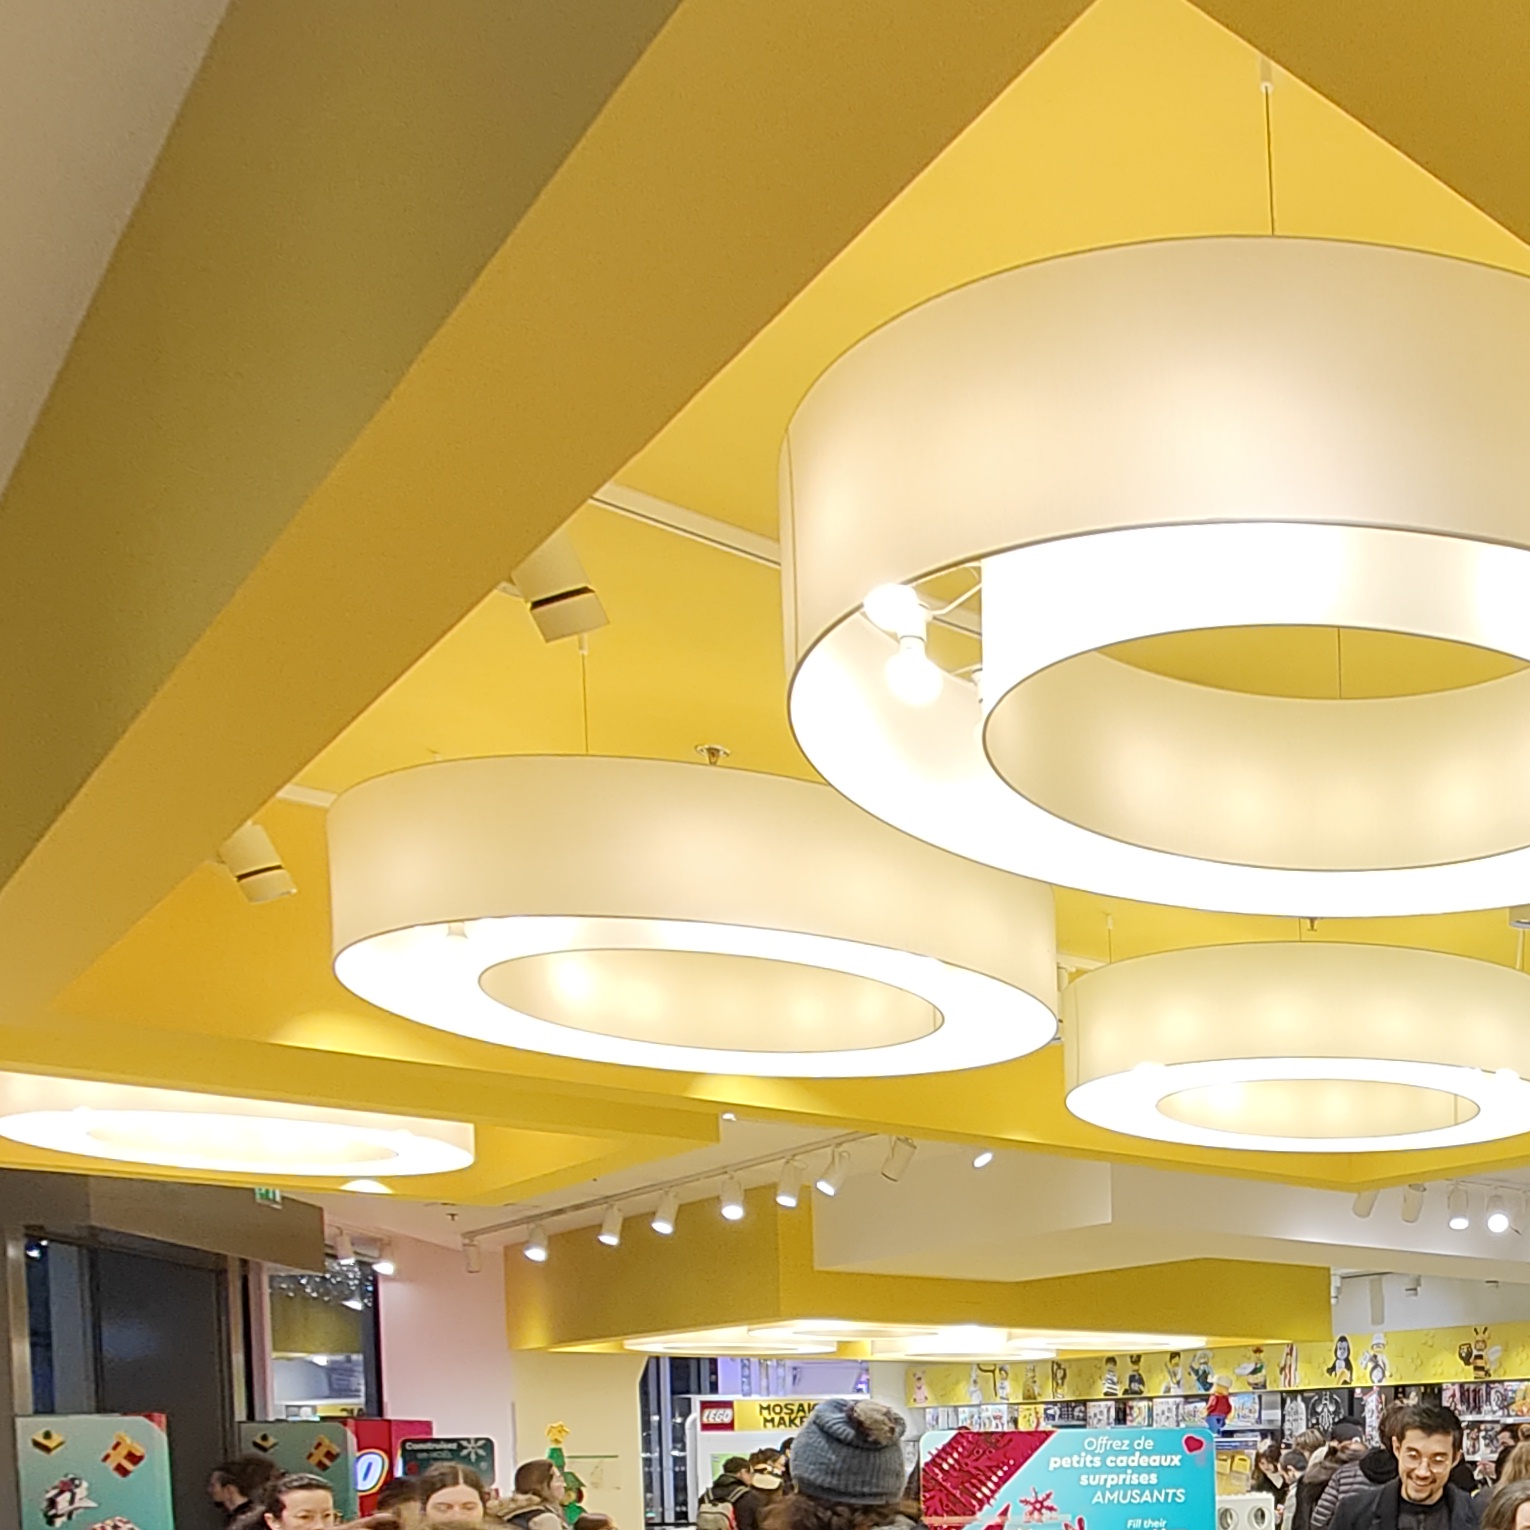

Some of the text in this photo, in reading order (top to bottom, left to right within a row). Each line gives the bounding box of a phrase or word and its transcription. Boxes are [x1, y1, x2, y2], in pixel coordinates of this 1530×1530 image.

[702, 1409, 732, 1423] LEGO
[1084, 1435, 1154, 1453] Offrez de
[1049, 1452, 1182, 1471] petits cadeaux
[1079, 1469, 1158, 1488] surprises
[1091, 1488, 1186, 1505] AMUSANTS
[1127, 1518, 1167, 1529] Fill their
